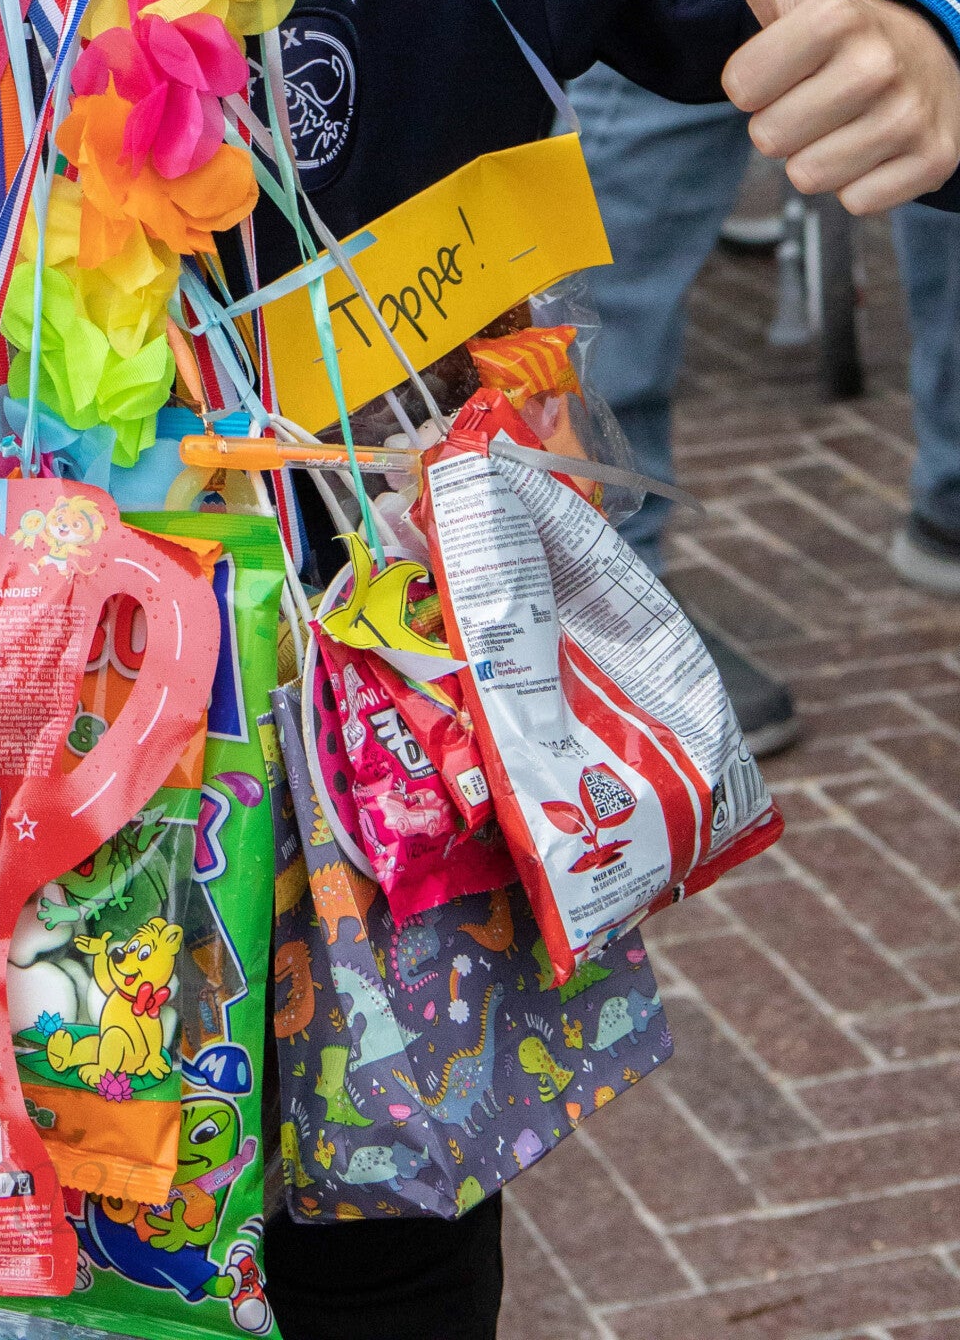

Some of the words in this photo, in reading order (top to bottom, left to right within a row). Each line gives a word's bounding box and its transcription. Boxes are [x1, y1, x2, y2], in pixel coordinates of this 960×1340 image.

[321, 108, 354, 166] AMSTERDAM
[592, 871, 607, 883] MEER
[607, 861, 628, 877] WETEN?
[591, 884, 600, 894] EN
